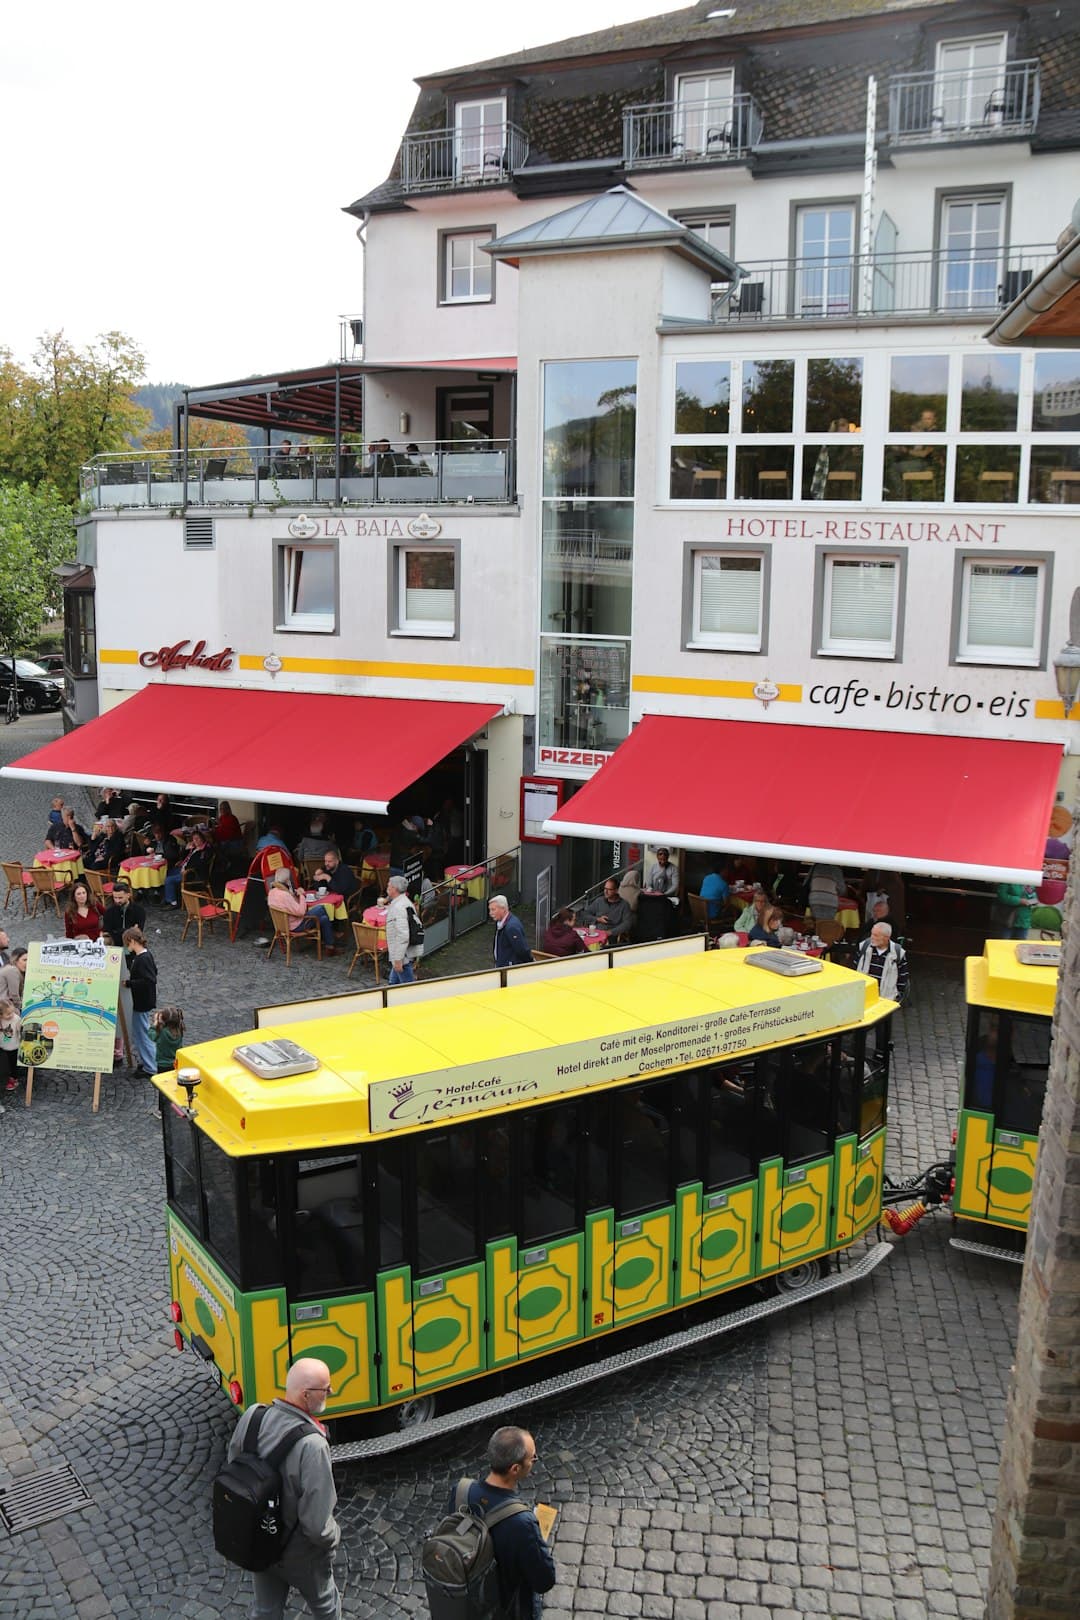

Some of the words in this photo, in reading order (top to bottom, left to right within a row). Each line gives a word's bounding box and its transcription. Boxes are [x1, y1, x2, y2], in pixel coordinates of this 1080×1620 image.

[323, 519, 348, 537] LA
[355, 519, 404, 537] BAIA
[727, 518, 1006, 544] HOTEL-RESTAURANT
[809, 679, 869, 714] cafe
[886, 681, 972, 713] bistro
[989, 691, 1031, 718] eis
[623, 1036, 636, 1047] mit
[638, 1034, 654, 1044] eig.
[656, 1025, 698, 1039] Konditorei
[705, 1017, 727, 1030] große
[557, 1063, 580, 1076] Hotel
[583, 1057, 609, 1070] direkt
[611, 1055, 622, 1064] an
[624, 1051, 638, 1061] der
[641, 1034, 711, 1057] Moselpromenade
[725, 1026, 751, 1040] großes
[639, 1057, 673, 1072] Cochem
[680, 1052, 693, 1061] Tel.
[696, 1038, 747, 1059] 02671-97750
